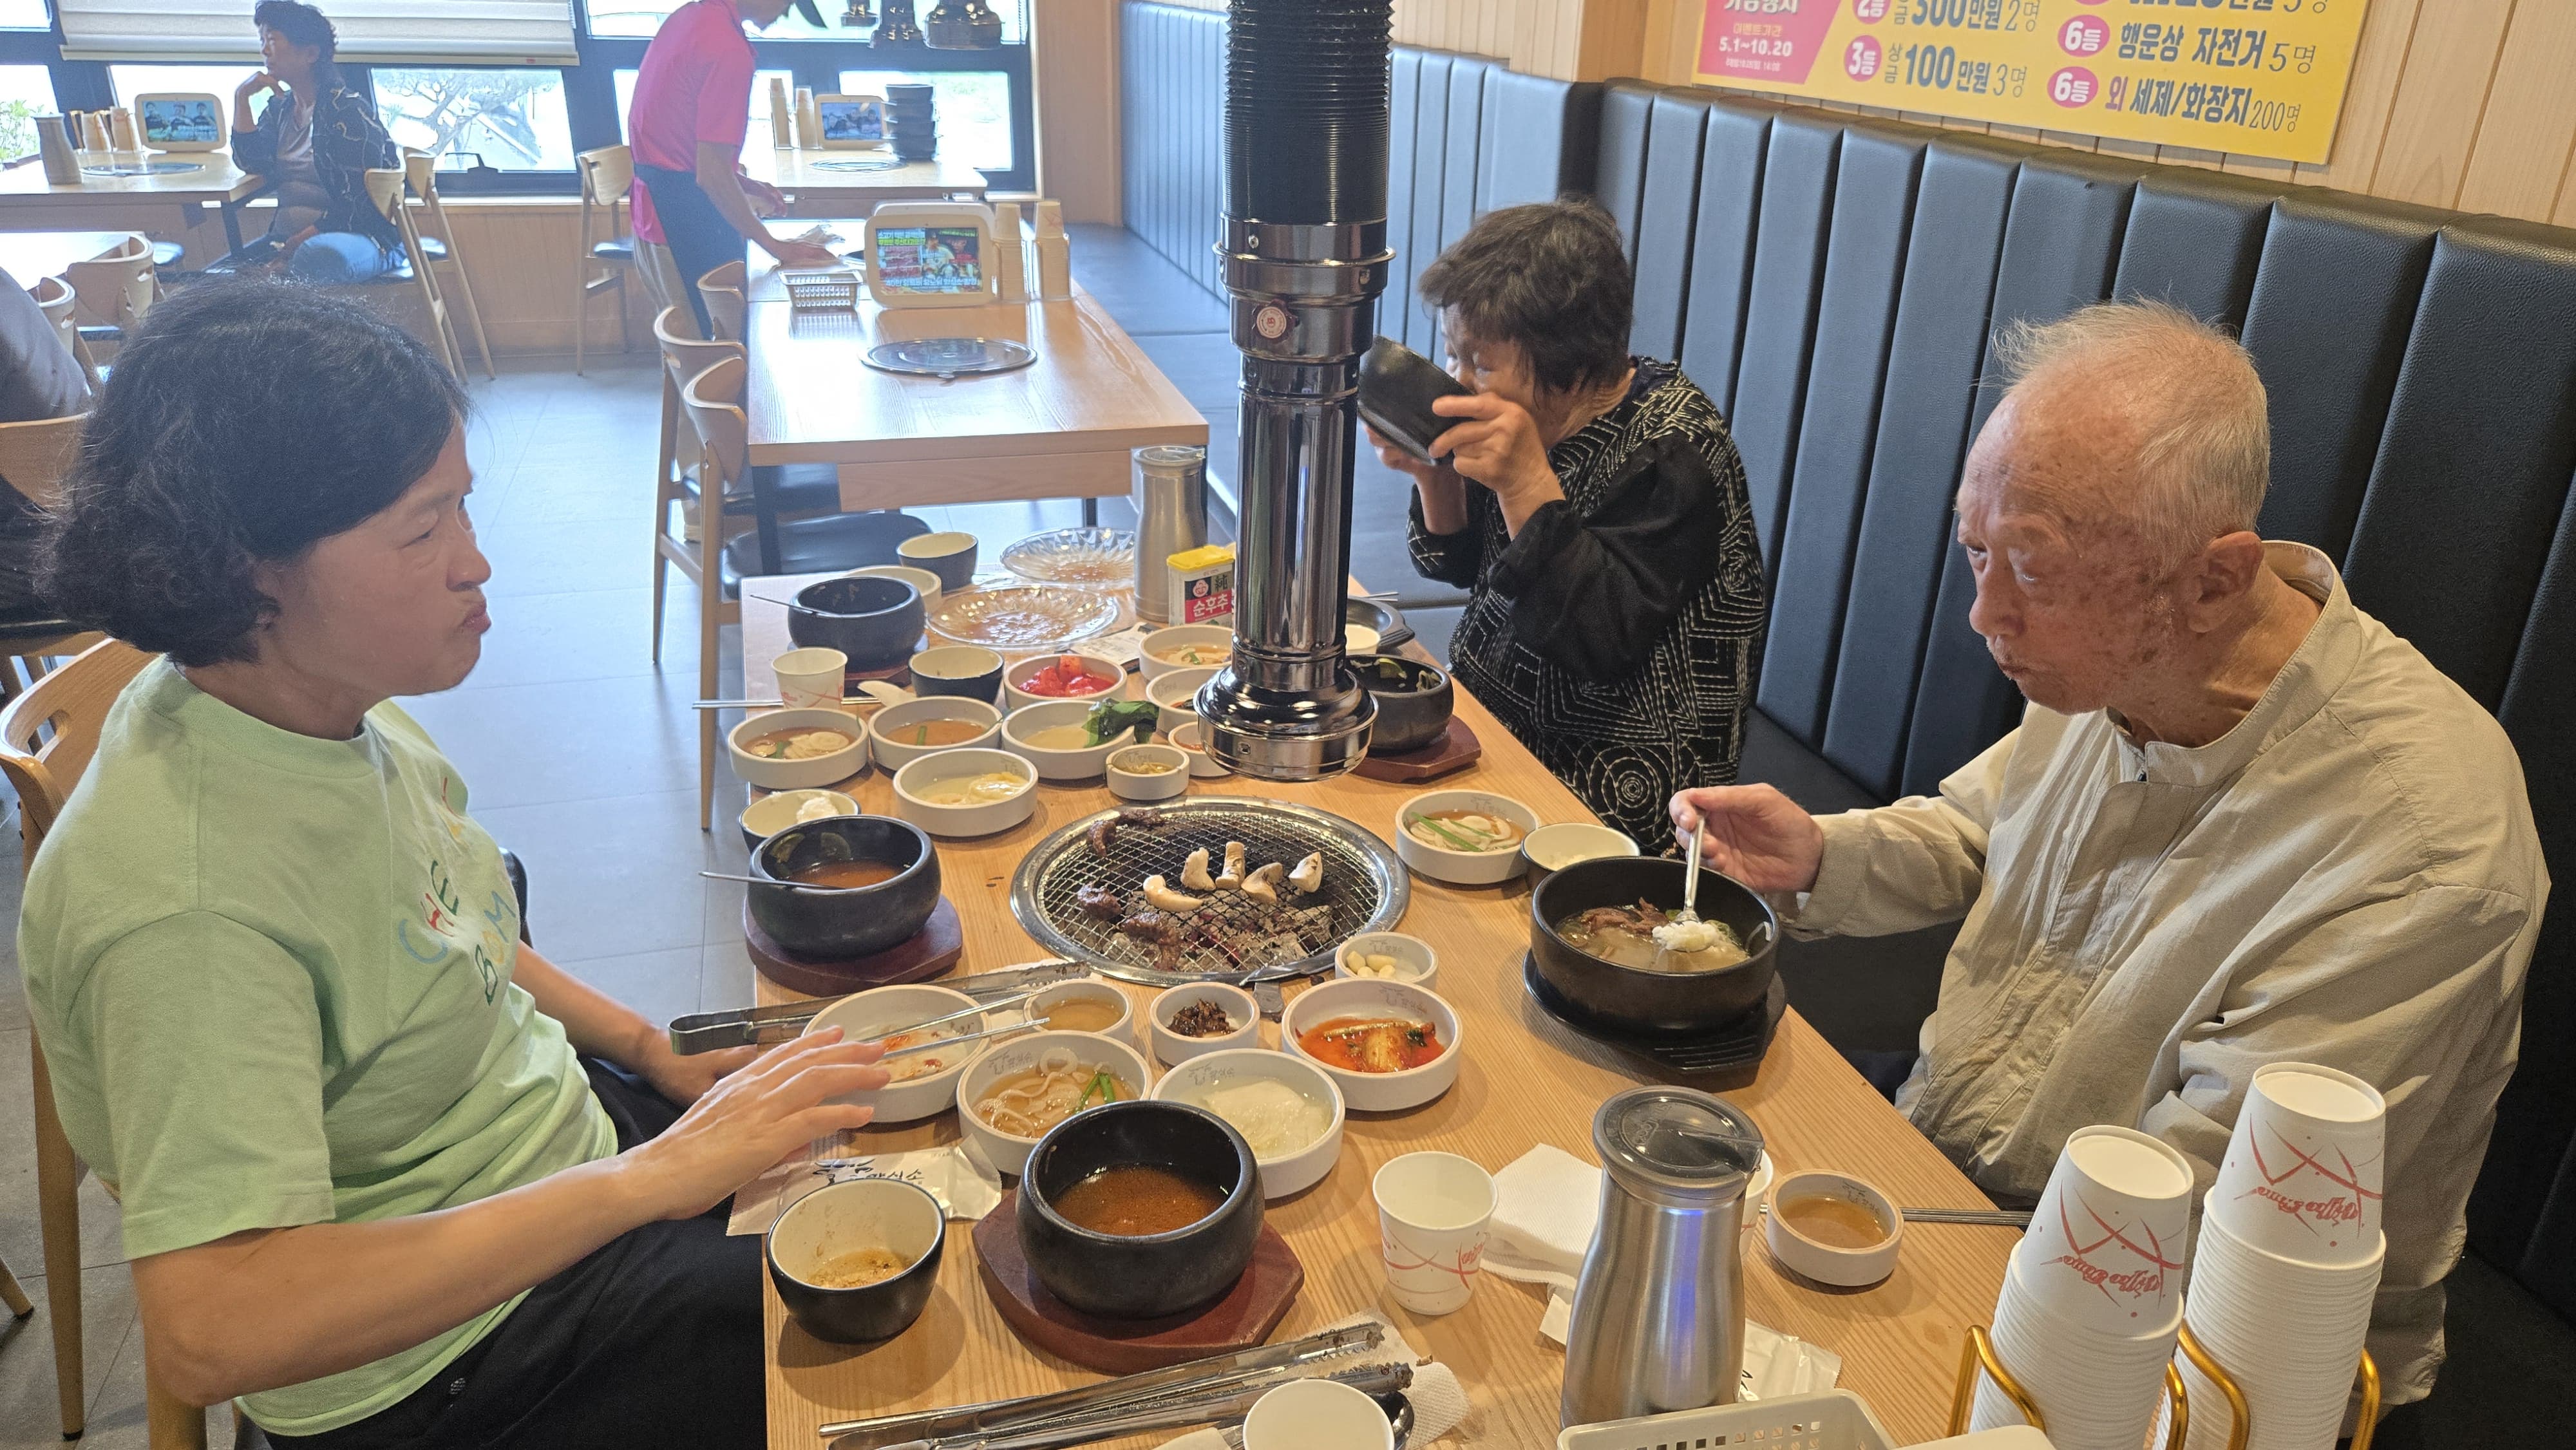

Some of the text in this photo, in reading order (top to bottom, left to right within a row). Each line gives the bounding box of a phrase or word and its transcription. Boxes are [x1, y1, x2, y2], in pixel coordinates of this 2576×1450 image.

[1719, 36, 1792, 57] 5.1~10.20
[1848, 42, 1876, 75] 3등
[1905, 43, 1991, 94] 100만원
[1993, 64, 2027, 98] 3명
[2065, 21, 2316, 73] 6등 행운상 자전거 5명
[2054, 72, 2301, 133] 6등 외 세제/화장지 200명
[1193, 594, 1228, 617] 순후추
